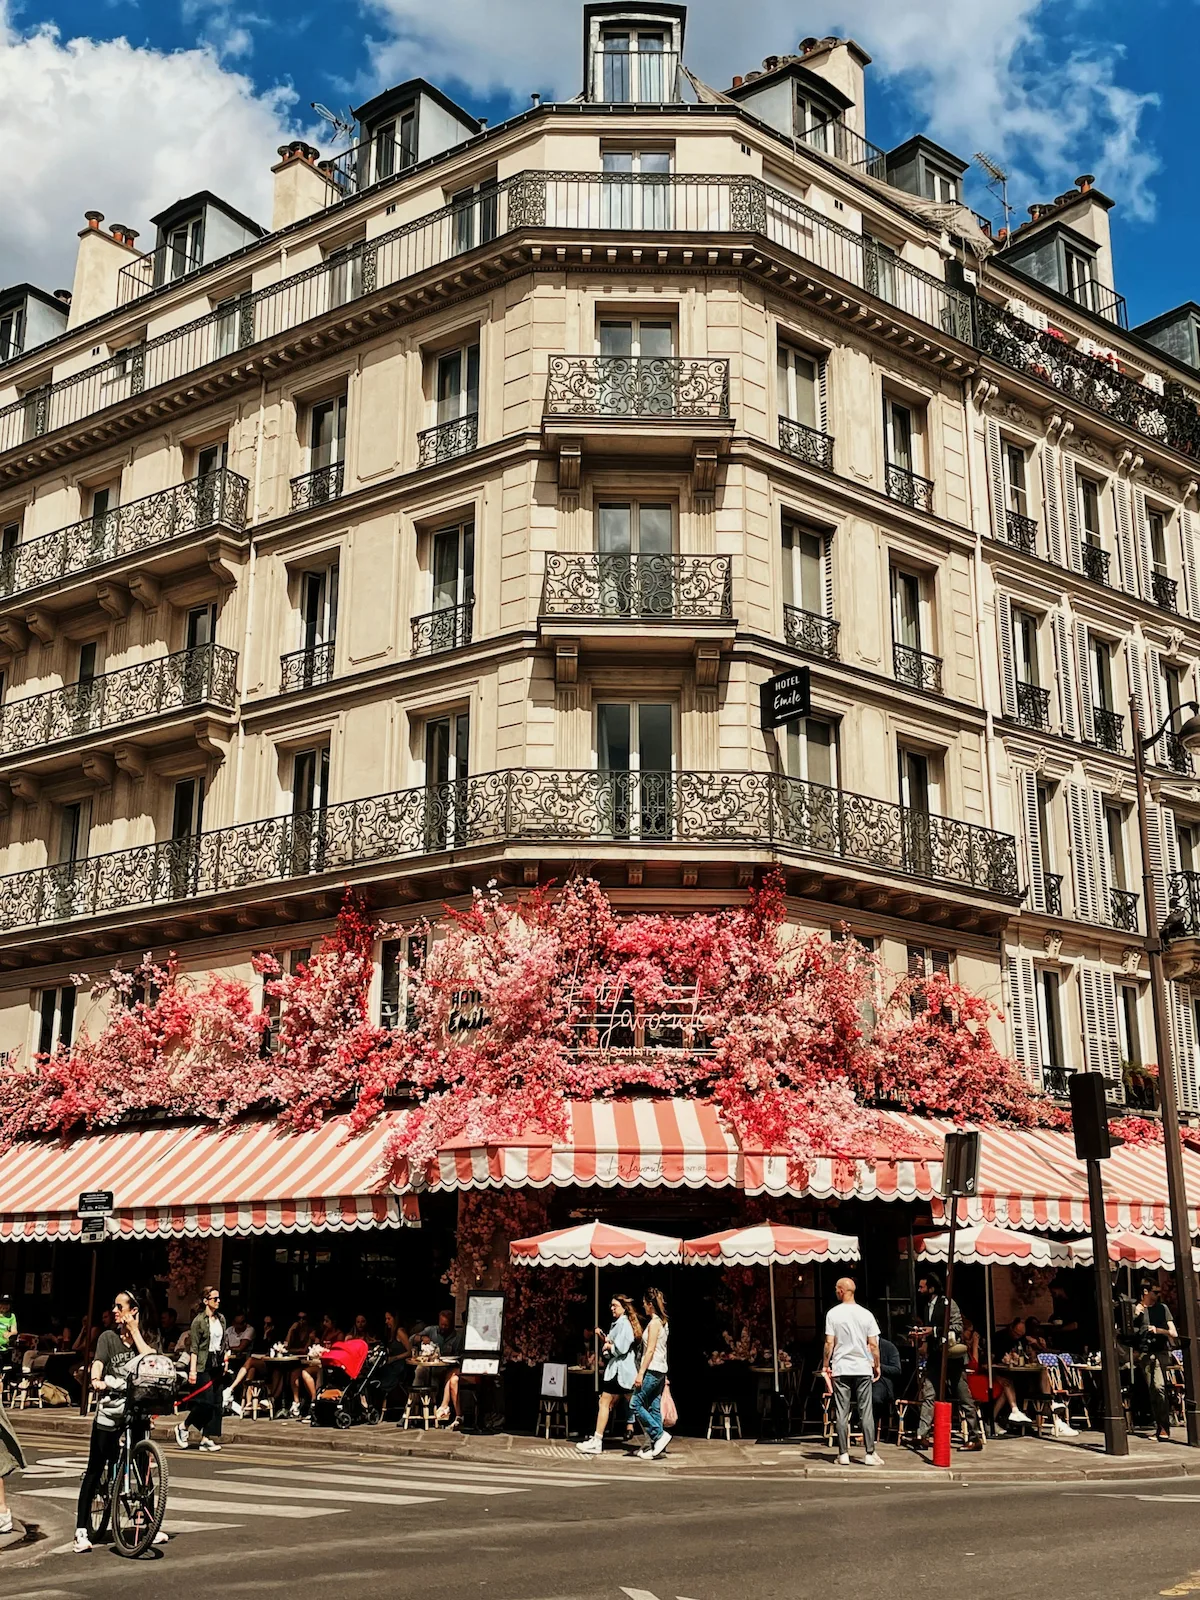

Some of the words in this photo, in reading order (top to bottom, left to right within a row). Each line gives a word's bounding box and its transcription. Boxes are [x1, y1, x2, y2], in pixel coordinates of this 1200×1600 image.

[775, 675, 800, 691] HOTEL
[773, 690, 801, 710] Emile
[625, 1154, 667, 1180] favorite
